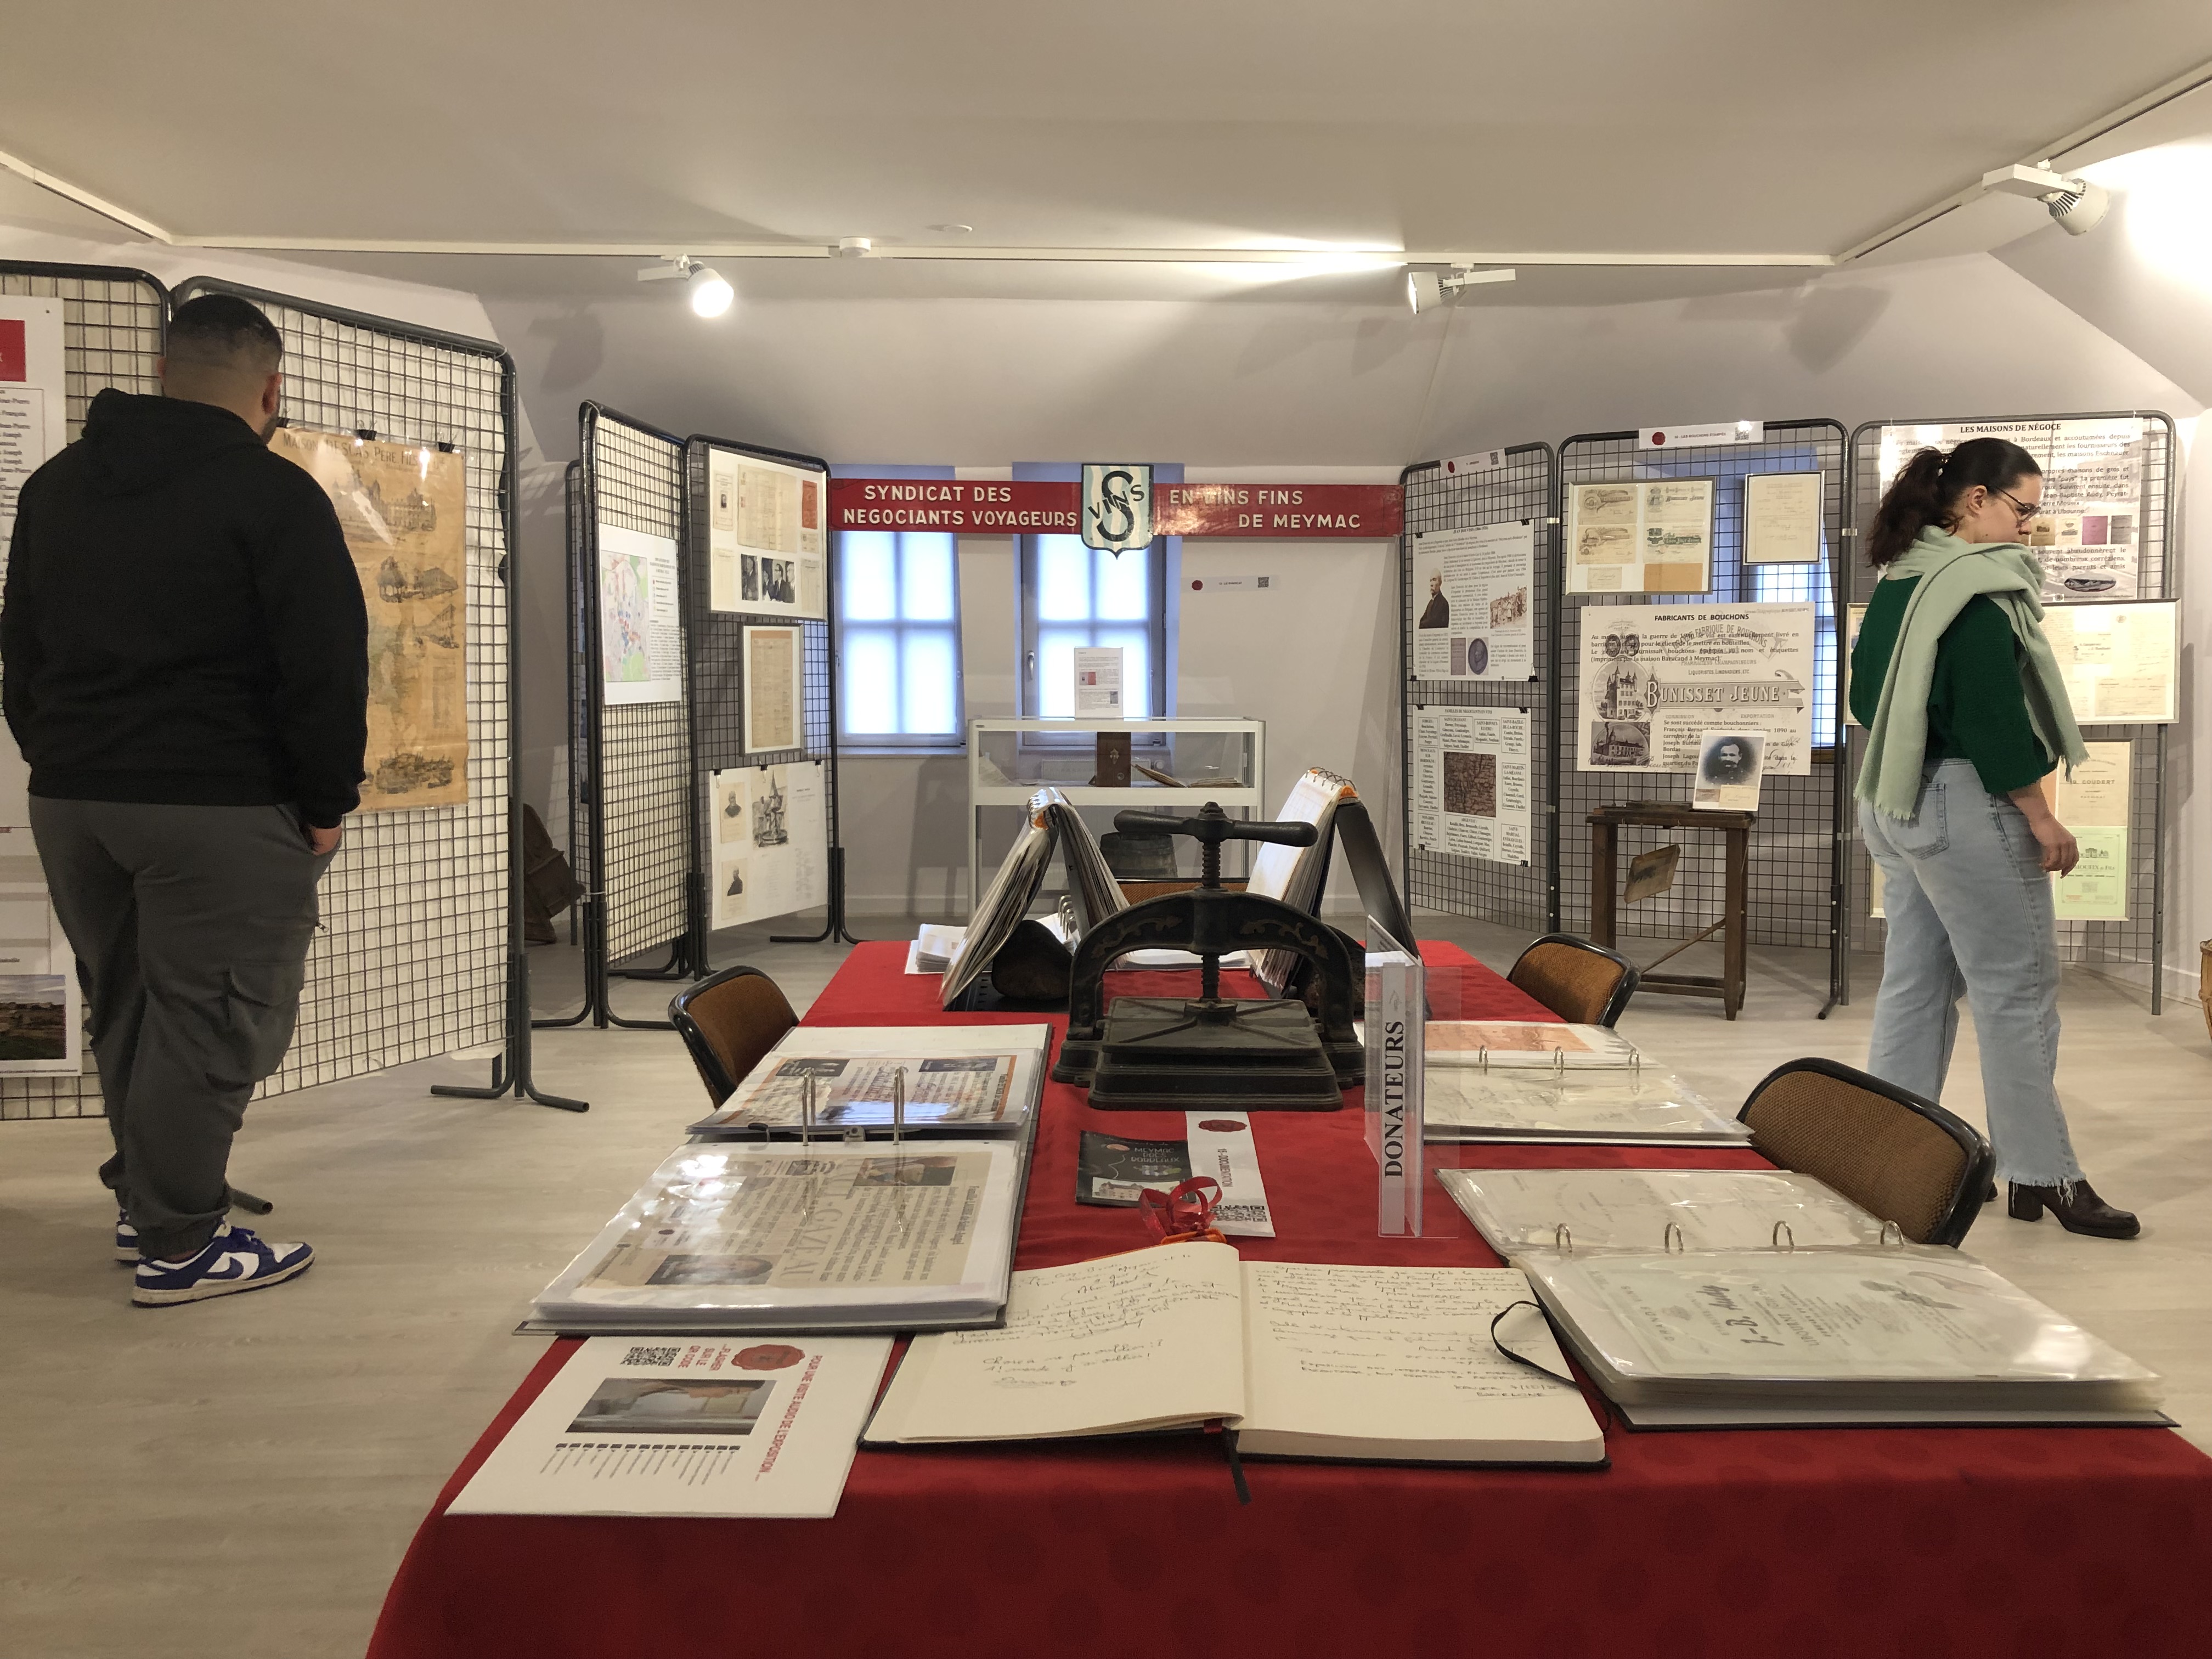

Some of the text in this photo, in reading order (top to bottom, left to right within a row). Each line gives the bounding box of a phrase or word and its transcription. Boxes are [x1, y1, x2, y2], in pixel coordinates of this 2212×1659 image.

[2028, 423, 2061, 431] NÉGOCE
[865, 486, 1012, 502] SYNDICAT DES
[1087, 484, 1145, 519] VINS
[1170, 490, 1303, 505] EN VINS FINS
[843, 509, 1077, 527] NEGOCIANTS VOYAGEURS
[1239, 514, 1361, 528] DE MEYMAC
[1726, 624, 1735, 634] DE
[1646, 681, 1780, 708] BUNISSET JEUNE
[1384, 1021, 1404, 1178] DONATEURS
[1218, 1155, 1233, 1187] DOCUMENTATION
[678, 1353, 696, 1368] CODE
[704, 1347, 715, 1358] SUR
[759, 1355, 823, 1473] POUR UNE VISITE AUDIO DE L'EXPOSITION
